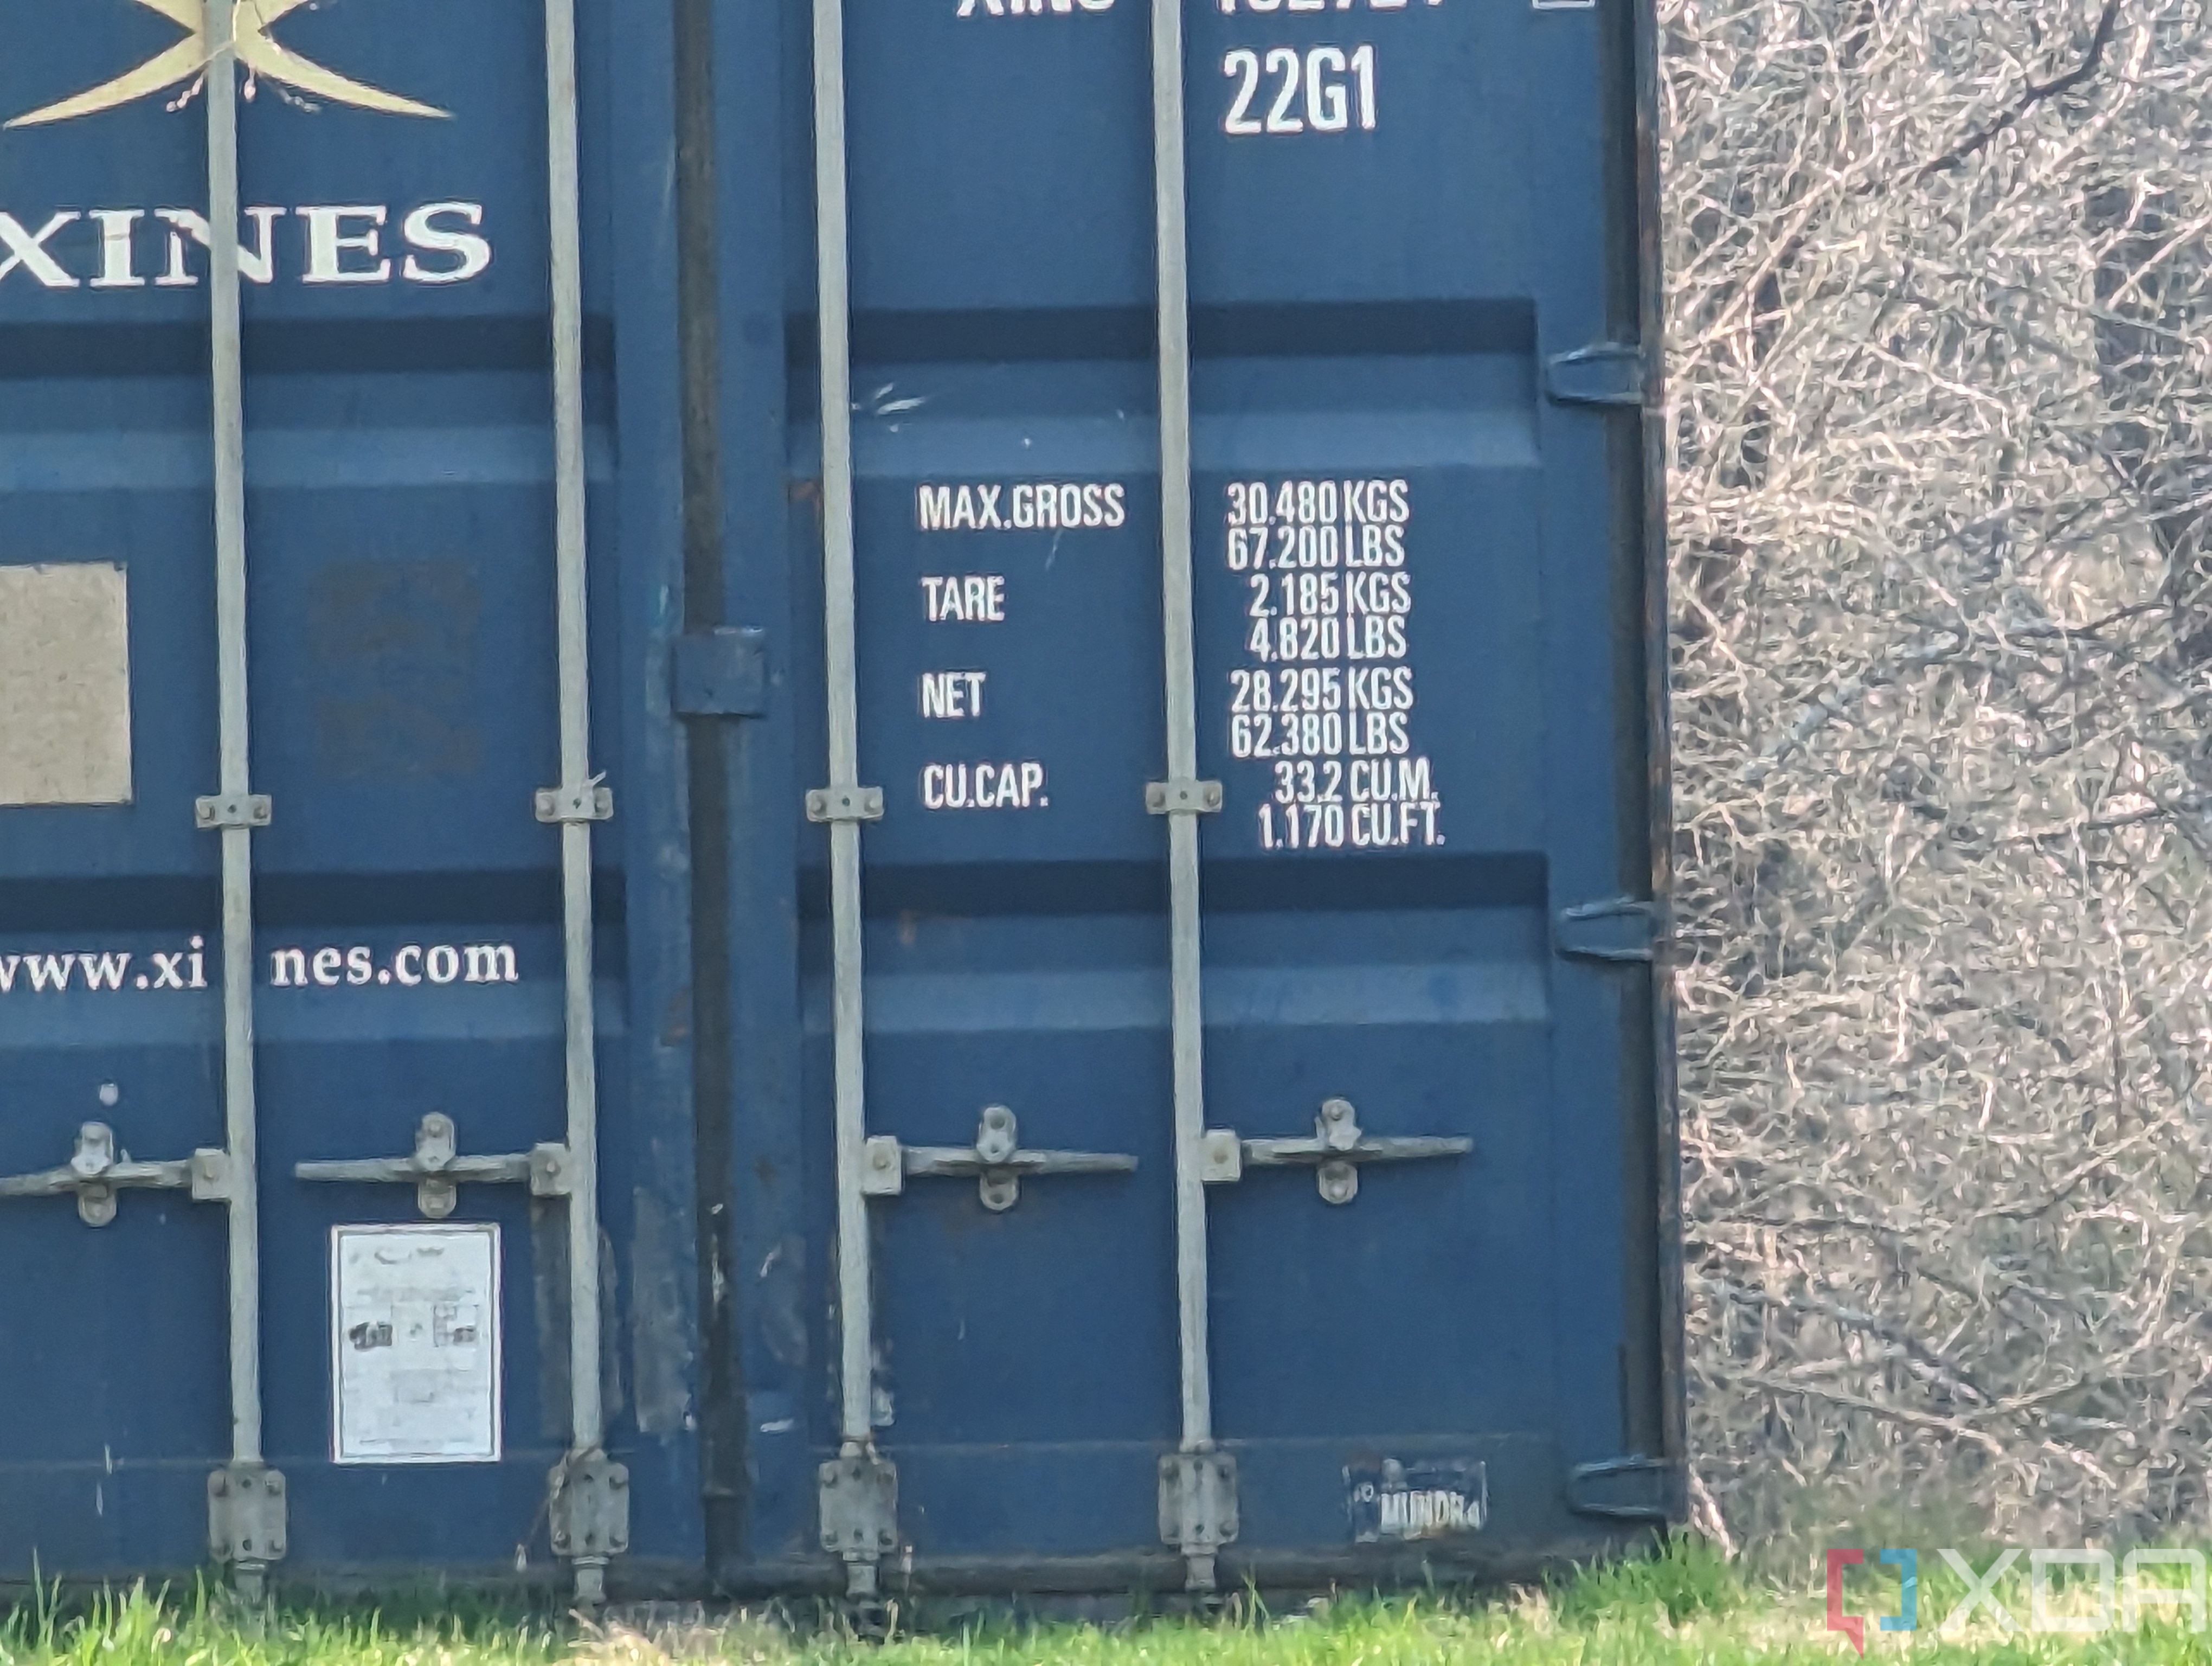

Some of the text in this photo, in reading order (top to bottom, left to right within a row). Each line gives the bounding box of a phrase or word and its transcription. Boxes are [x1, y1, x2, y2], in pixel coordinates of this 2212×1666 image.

[1223, 44, 1377, 134] 22G1
[0, 202, 490, 287] XINES
[918, 479, 1410, 530] MAX.GROSS 30.480 KGS
[1227, 523, 1405, 570] 67.200 LBS
[921, 571, 1412, 622] TARE 2.185 KGS
[1249, 614, 1407, 662] 4.820 LBS
[922, 665, 1414, 719] NET 28.295 KGS
[1231, 709, 1410, 758] 62.380 LBS
[923, 757, 1439, 810] CU.CAP. 33.2 CU.M.
[1258, 802, 1445, 849] 1.170 CU.FT.
